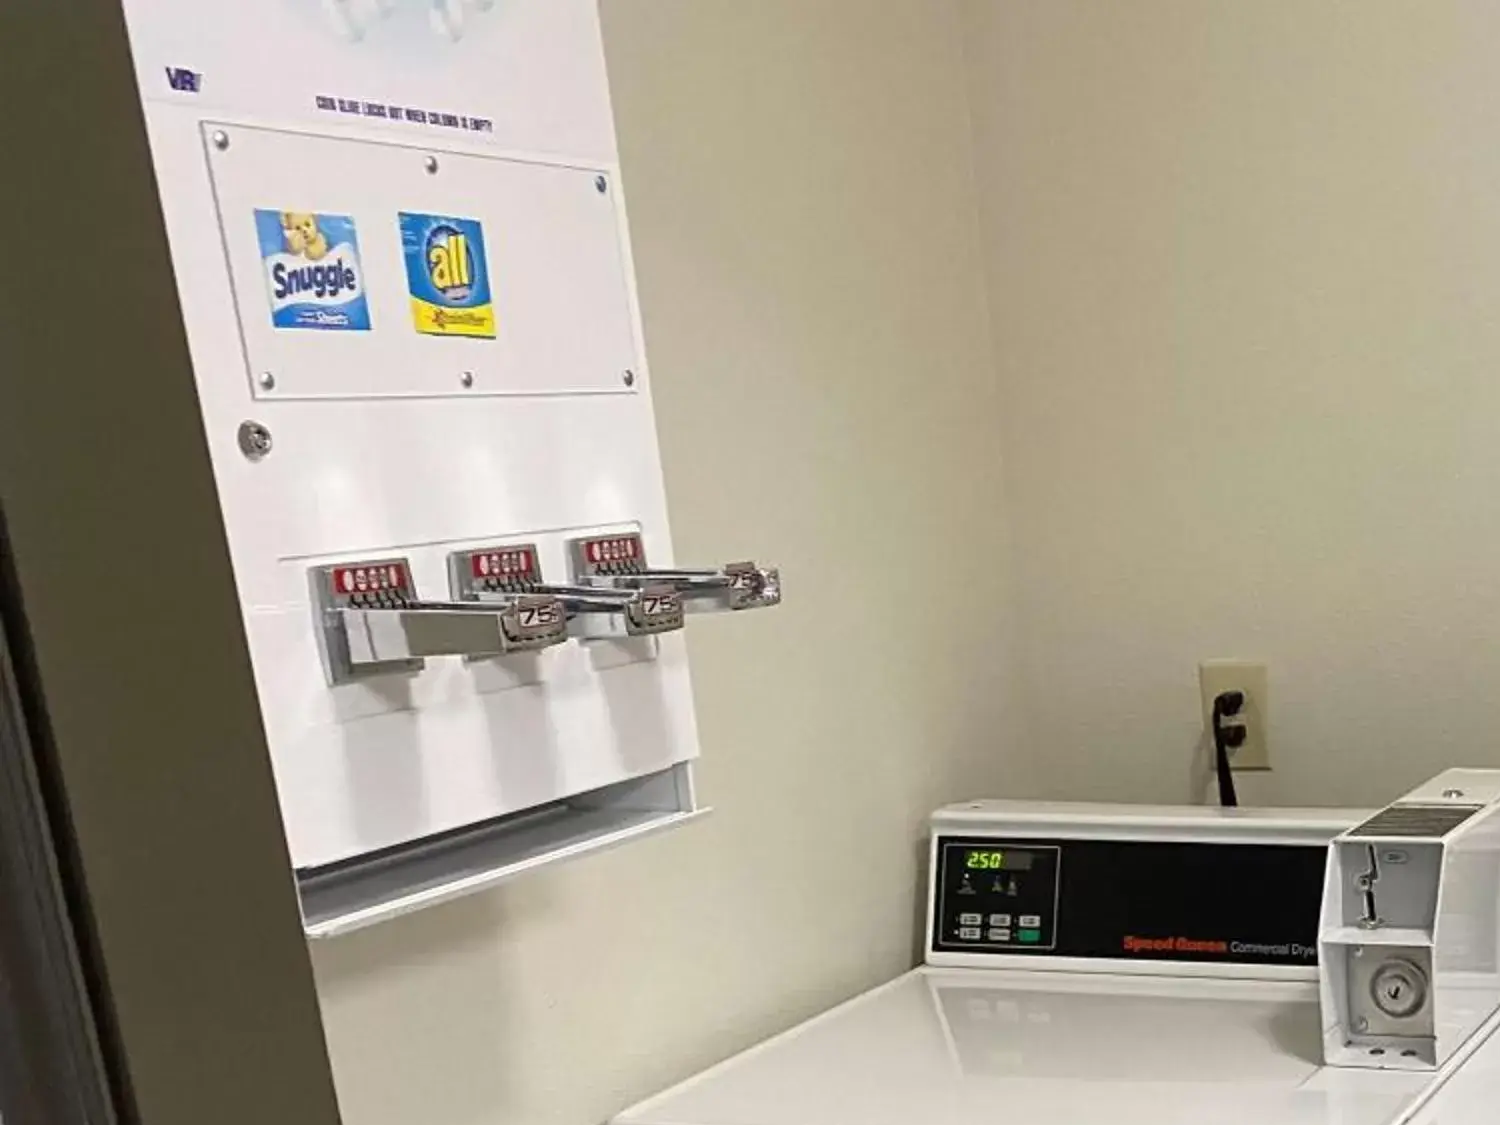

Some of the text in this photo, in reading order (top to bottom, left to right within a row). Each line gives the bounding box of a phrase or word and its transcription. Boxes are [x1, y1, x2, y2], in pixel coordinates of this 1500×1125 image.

[273, 256, 356, 298] Snuggle
[429, 233, 469, 290] all
[1123, 936, 1174, 952] Speed
[1230, 940, 1290, 956] Commercial
